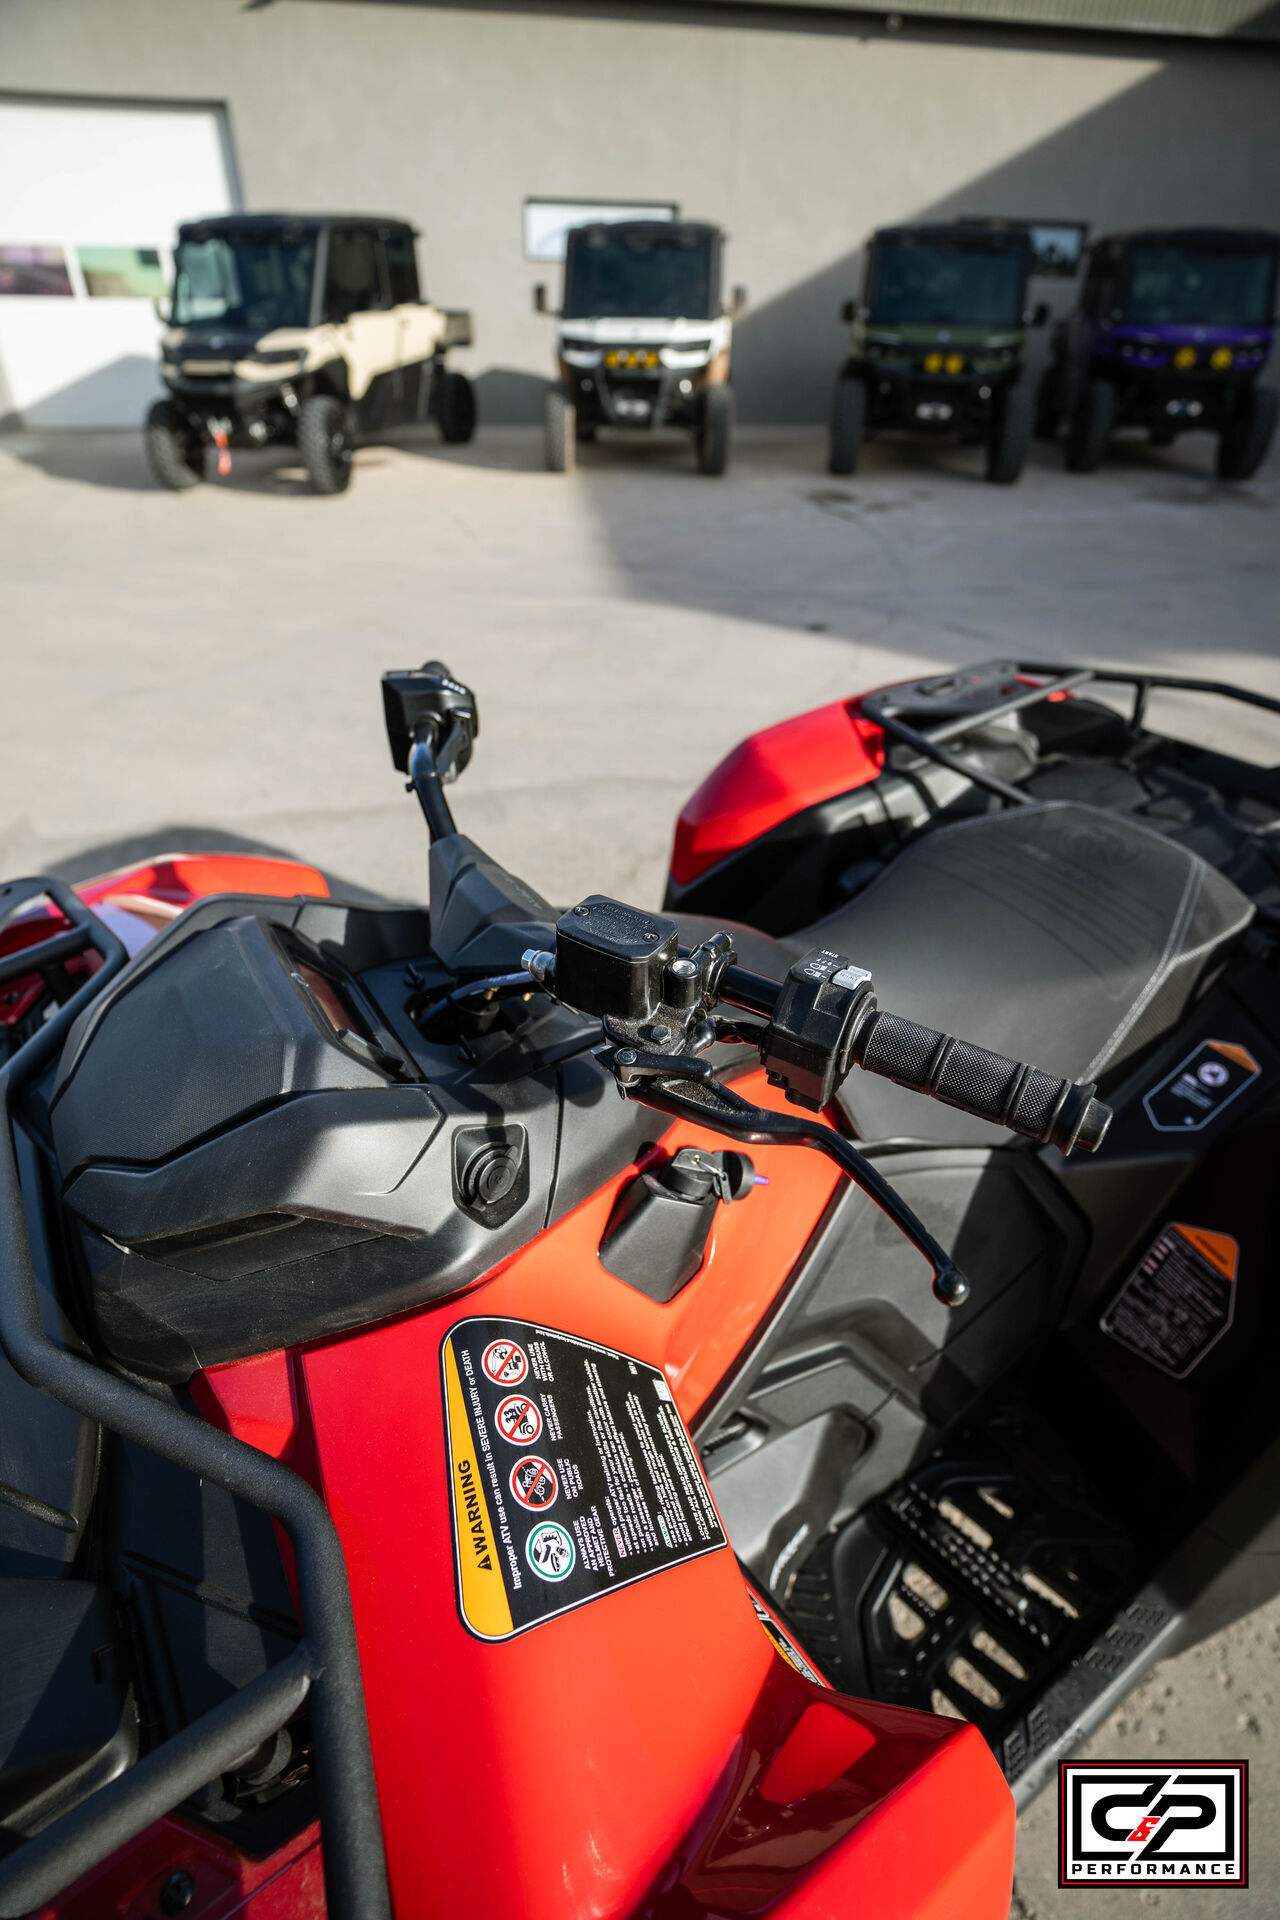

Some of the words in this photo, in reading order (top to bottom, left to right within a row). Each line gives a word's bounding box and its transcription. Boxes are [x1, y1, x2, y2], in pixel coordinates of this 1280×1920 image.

[527, 1343, 535, 1357] USE
[533, 1341, 544, 1364] DRUGS
[539, 1341, 552, 1371] ALCOHOL
[461, 1349, 474, 1376] DEATH
[531, 1357, 541, 1379] NEVER
[539, 1364, 548, 1381] WITH
[468, 1376, 476, 1386] or
[547, 1371, 554, 1382] OR
[590, 1362, 602, 1387] steering
[469, 1387, 483, 1416] INJURY
[586, 1385, 600, 1419] conditions.
[590, 1382, 602, 1406] another
[597, 1387, 606, 1400] and
[539, 1393, 550, 1417] CARRY
[598, 1406, 606, 1420] with
[602, 1400, 614, 1425] balance
[625, 1400, 636, 1423] vehicle
[547, 1394, 563, 1439] PASSENGERS
[635, 1416, 643, 1428] and
[476, 1416, 490, 1452] SEVERE
[546, 1417, 557, 1441] NEVER
[586, 1409, 601, 1446] instruction.
[599, 1431, 606, 1440] or
[603, 1420, 613, 1440] occur
[610, 1425, 621, 1444] affect
[632, 1423, 642, 1441] avoid
[643, 1422, 651, 1436] may
[602, 1440, 612, 1458] skills
[609, 1440, 617, 1453] can
[639, 1441, 645, 1449] to
[640, 1429, 650, 1450] terrain
[485, 1453, 493, 1462] in
[597, 1446, 604, 1455] or
[647, 1436, 662, 1467] pavement
[647, 1450, 657, 1470] rough
[486, 1461, 499, 1487] result
[556, 1458, 565, 1473] USE
[563, 1458, 575, 1485] PUBLIC
[600, 1455, 612, 1482] training
[608, 1458, 618, 1475] your
[613, 1453, 626, 1482] collision
[617, 1444, 634, 1483] passengers
[626, 1457, 637, 1478] losing
[642, 1449, 658, 1484] techniques
[673, 1446, 694, 1495] INSTRUCTIONS
[560, 1474, 572, 1499] NEVER
[572, 1464, 584, 1490] ROADS
[632, 1478, 640, 1486] of
[654, 1470, 662, 1483] and
[660, 1472, 673, 1500] surfaces
[667, 1478, 675, 1491] and
[680, 1476, 690, 1495] READ
[493, 1488, 503, 1505] can
[570, 1485, 579, 1498] ON
[607, 1482, 617, 1497] ATV
[616, 1486, 625, 1500] fast
[636, 1486, 645, 1500] risk
[654, 1485, 665, 1505] riding
[659, 1483, 667, 1498] hills
[458, 1460, 487, 1555] WARNING
[604, 1495, 617, 1526] operate:
[613, 1497, 625, 1522] proper
[621, 1501, 629, 1514] too
[626, 1493, 636, 1514] roads
[631, 1487, 647, 1524] passenger
[664, 1499, 671, 1509] on
[670, 1501, 682, 1522] paved
[687, 1496, 696, 1511] AND
[691, 1495, 700, 1509] ALL
[498, 1506, 507, 1524] use
[586, 1517, 596, 1534] AND
[590, 1505, 601, 1527] GEAR
[632, 1514, 644, 1537] public
[641, 1501, 654, 1531] increase
[661, 1505, 673, 1529] proper
[696, 1509, 711, 1540] FOLLOW
[499, 1525, 512, 1544] ATV
[572, 1520, 582, 1537] USE
[579, 1515, 595, 1558] APPROVED
[620, 1522, 632, 1551] without
[625, 1514, 637, 1541] speeds
[668, 1509, 682, 1543] overturns
[677, 1522, 688, 1542] avoid
[692, 1512, 706, 1540] LOCATE
[613, 1528, 626, 1557] NEVER
[633, 1541, 640, 1550] at
[640, 1538, 647, 1548] on
[644, 1531, 653, 1547] with
[650, 1532, 659, 1546] and
[577, 1537, 591, 1569] ALWAYS
[591, 1535, 605, 1567] HELMET
[596, 1528, 615, 1577] PROTECTIVE
[506, 1545, 522, 1589] Improper
[590, 1558, 599, 1571] AN
